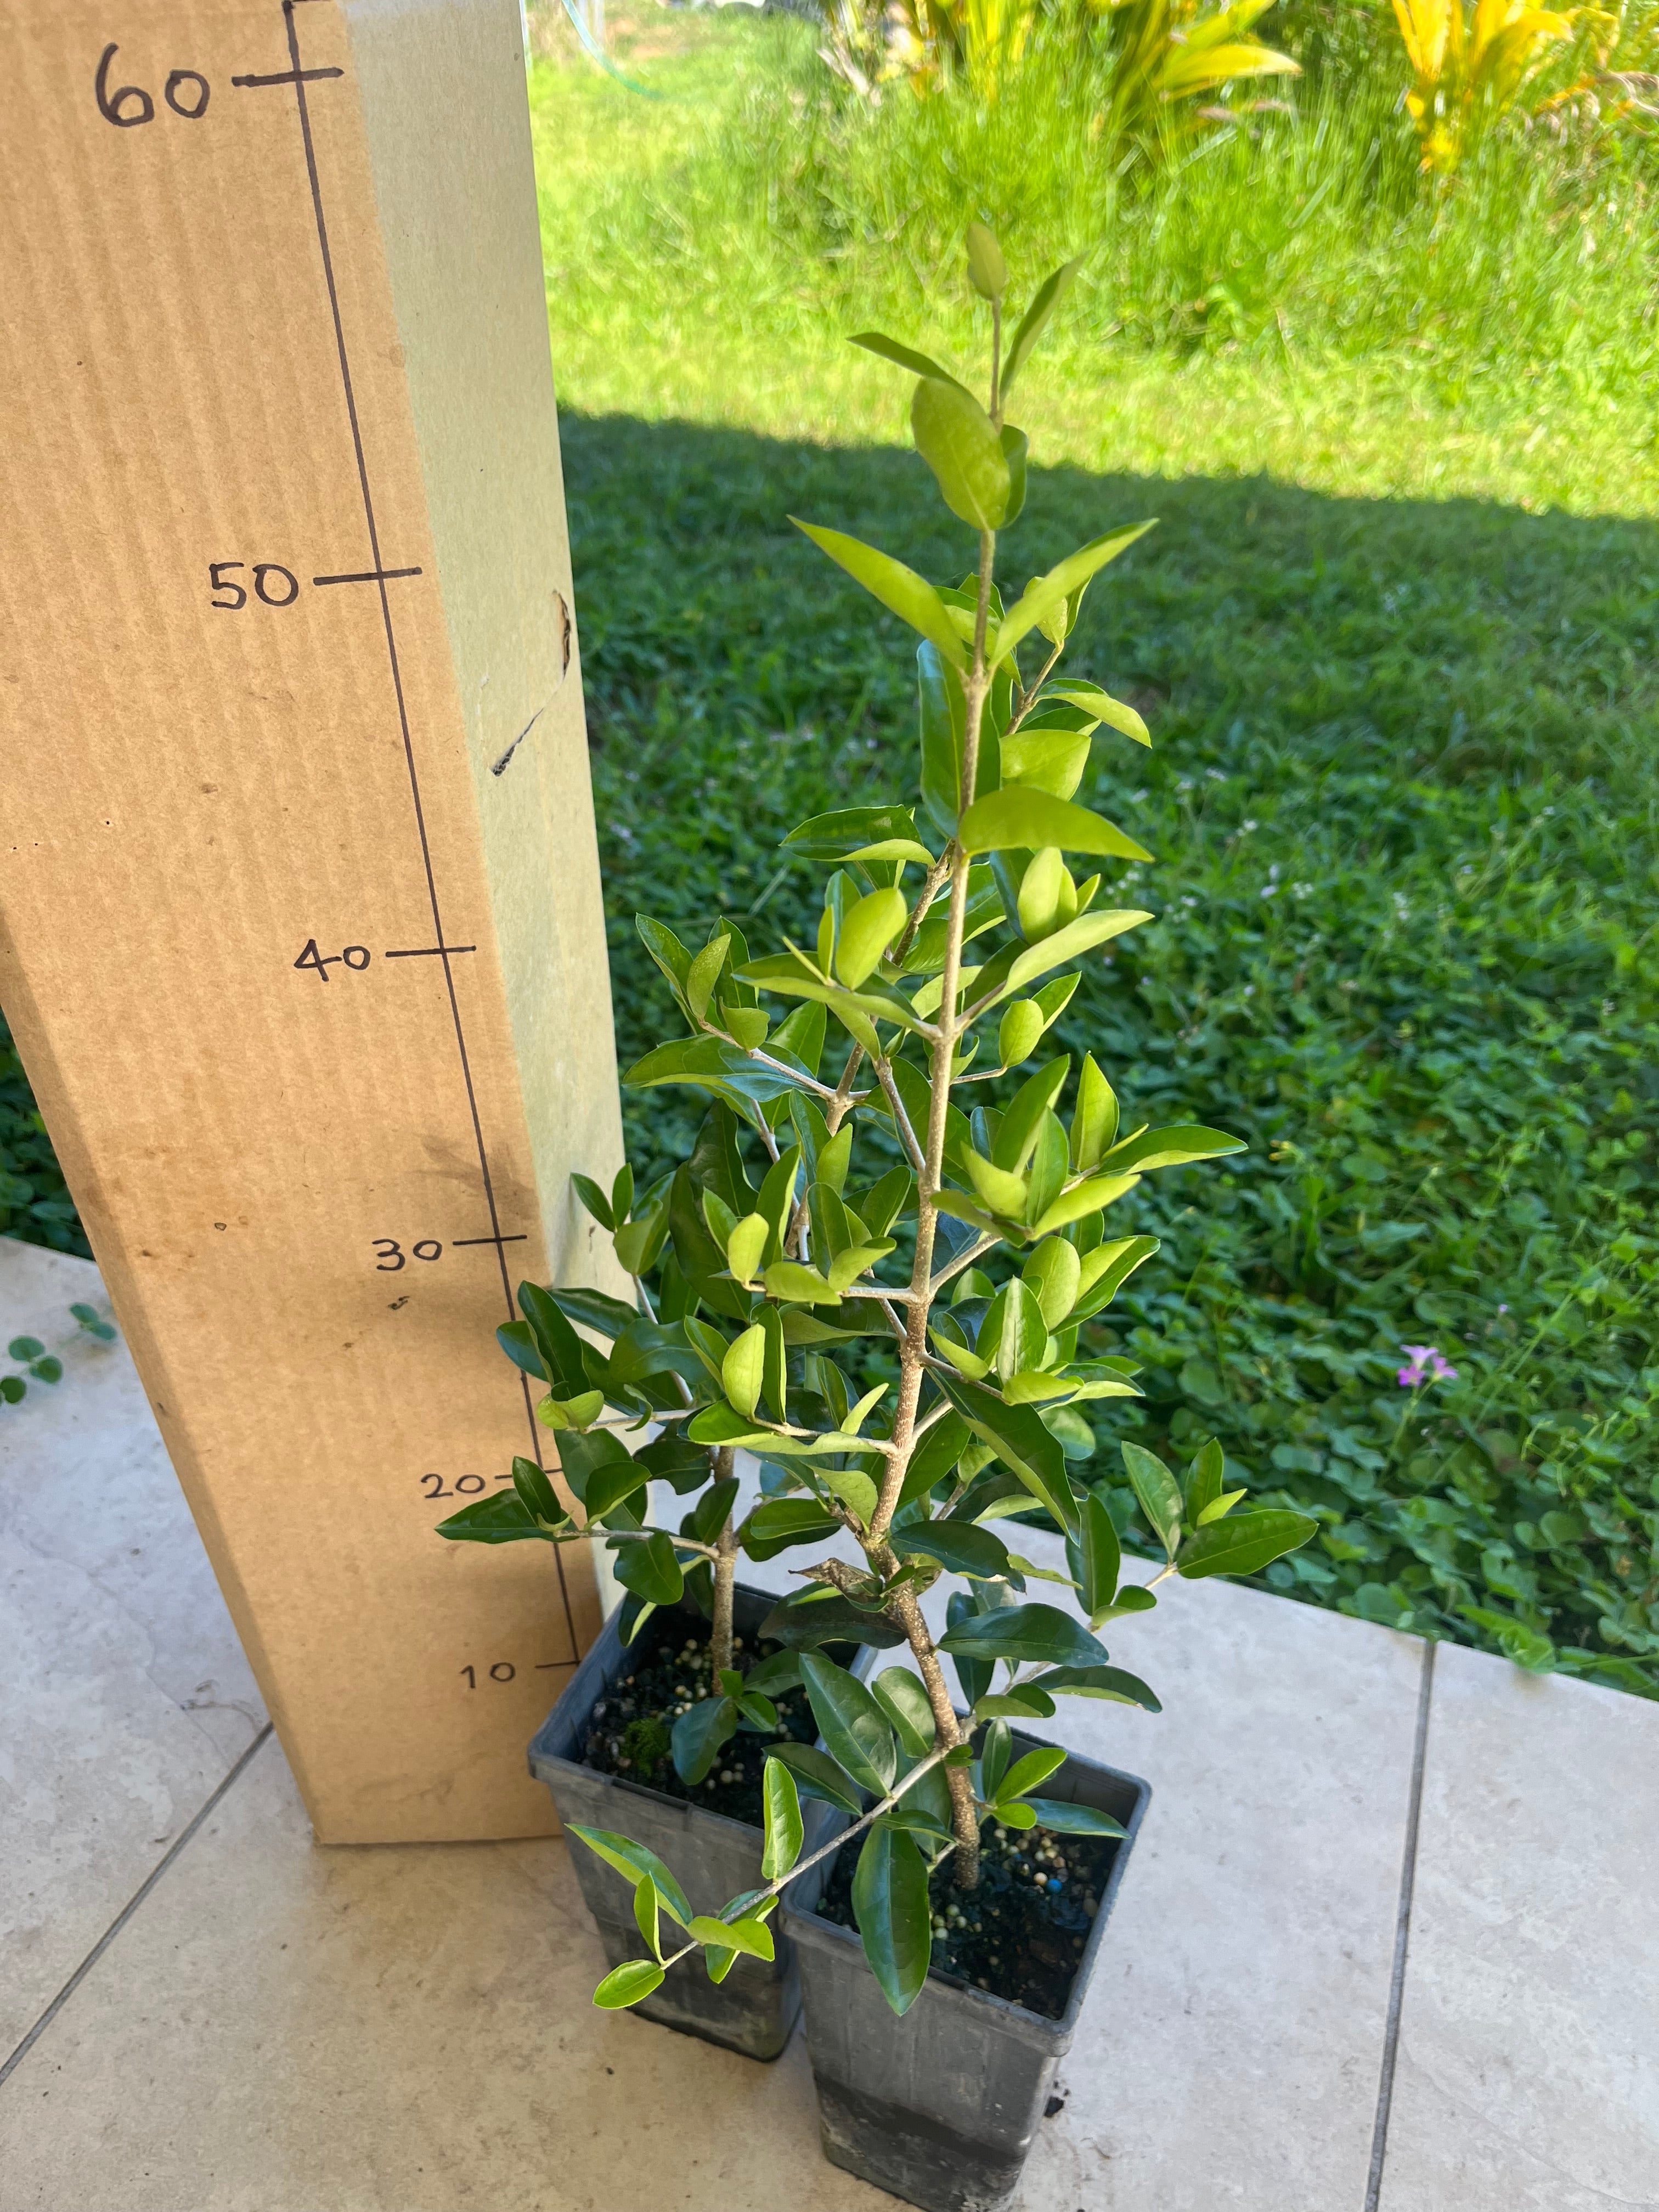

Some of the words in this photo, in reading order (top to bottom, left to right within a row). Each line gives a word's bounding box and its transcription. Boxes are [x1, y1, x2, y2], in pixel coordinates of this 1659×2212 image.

[94, 42, 211, 128] 60
[208, 561, 300, 611] 50
[292, 938, 371, 983] 40
[371, 1238, 443, 1272] 30
[420, 1473, 487, 1499] 20
[459, 1662, 516, 1690] 10
